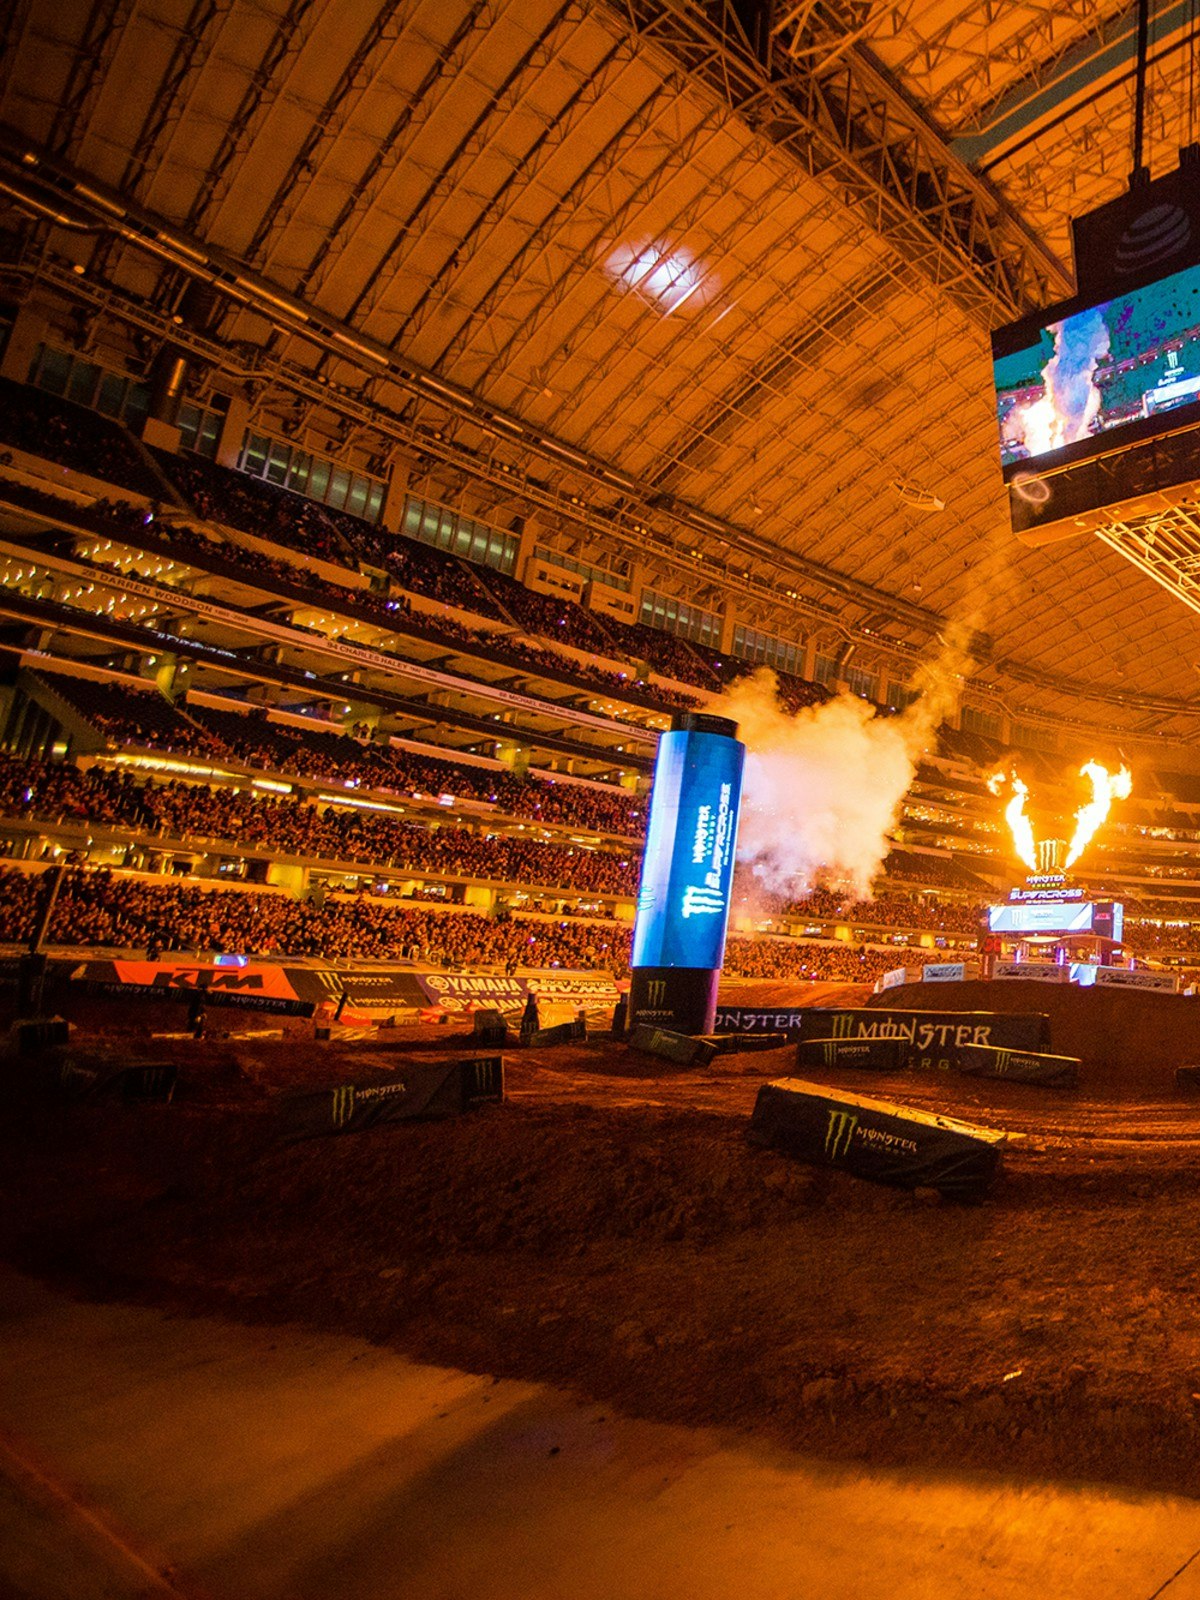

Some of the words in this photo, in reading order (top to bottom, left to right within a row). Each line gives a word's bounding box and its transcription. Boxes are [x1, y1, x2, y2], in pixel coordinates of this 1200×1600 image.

[100, 573, 151, 594] DARREN
[155, 590, 213, 612] WOODSON
[340, 645, 380, 662] CHARLES
[381, 657, 408, 670] HALEY
[152, 967, 264, 989] KTM
[446, 977, 523, 991] YAMAHA
[714, 1010, 802, 1031] ONSTER
[858, 1017, 993, 1049] MONSTER
[356, 1083, 406, 1099] MONSTER
[856, 1126, 917, 1152] MONSTER
